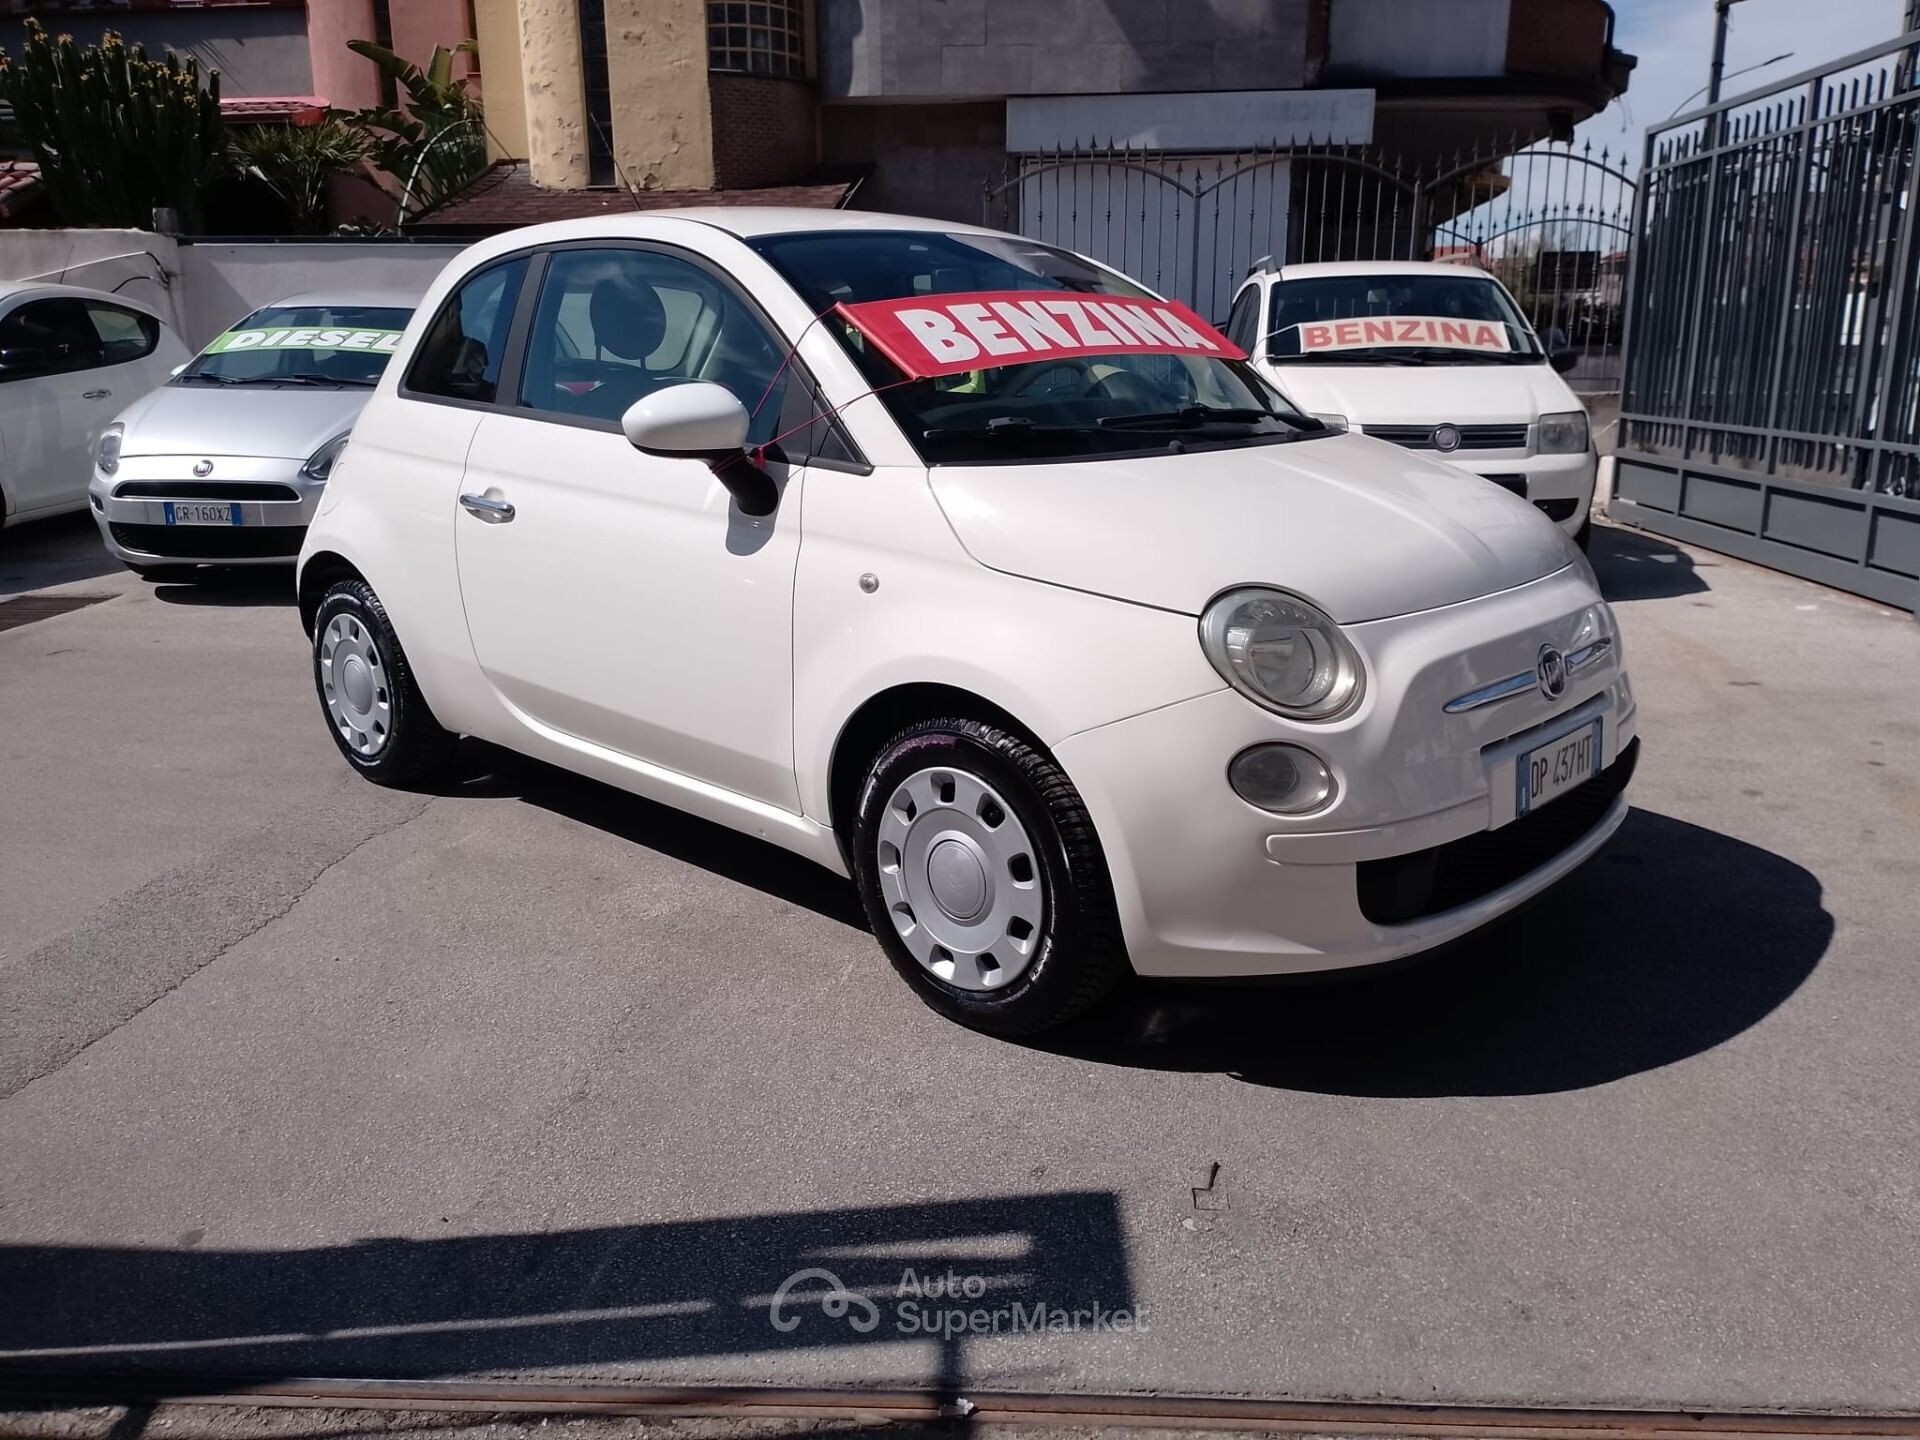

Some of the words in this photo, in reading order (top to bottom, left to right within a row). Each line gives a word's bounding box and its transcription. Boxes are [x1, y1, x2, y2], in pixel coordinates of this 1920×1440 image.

[224, 330, 401, 351] DIESEL
[894, 300, 1220, 364] BENZINA
[1303, 321, 1503, 350] BENZINA
[1531, 757, 1548, 799] DP
[1552, 735, 1592, 786] 437HT
